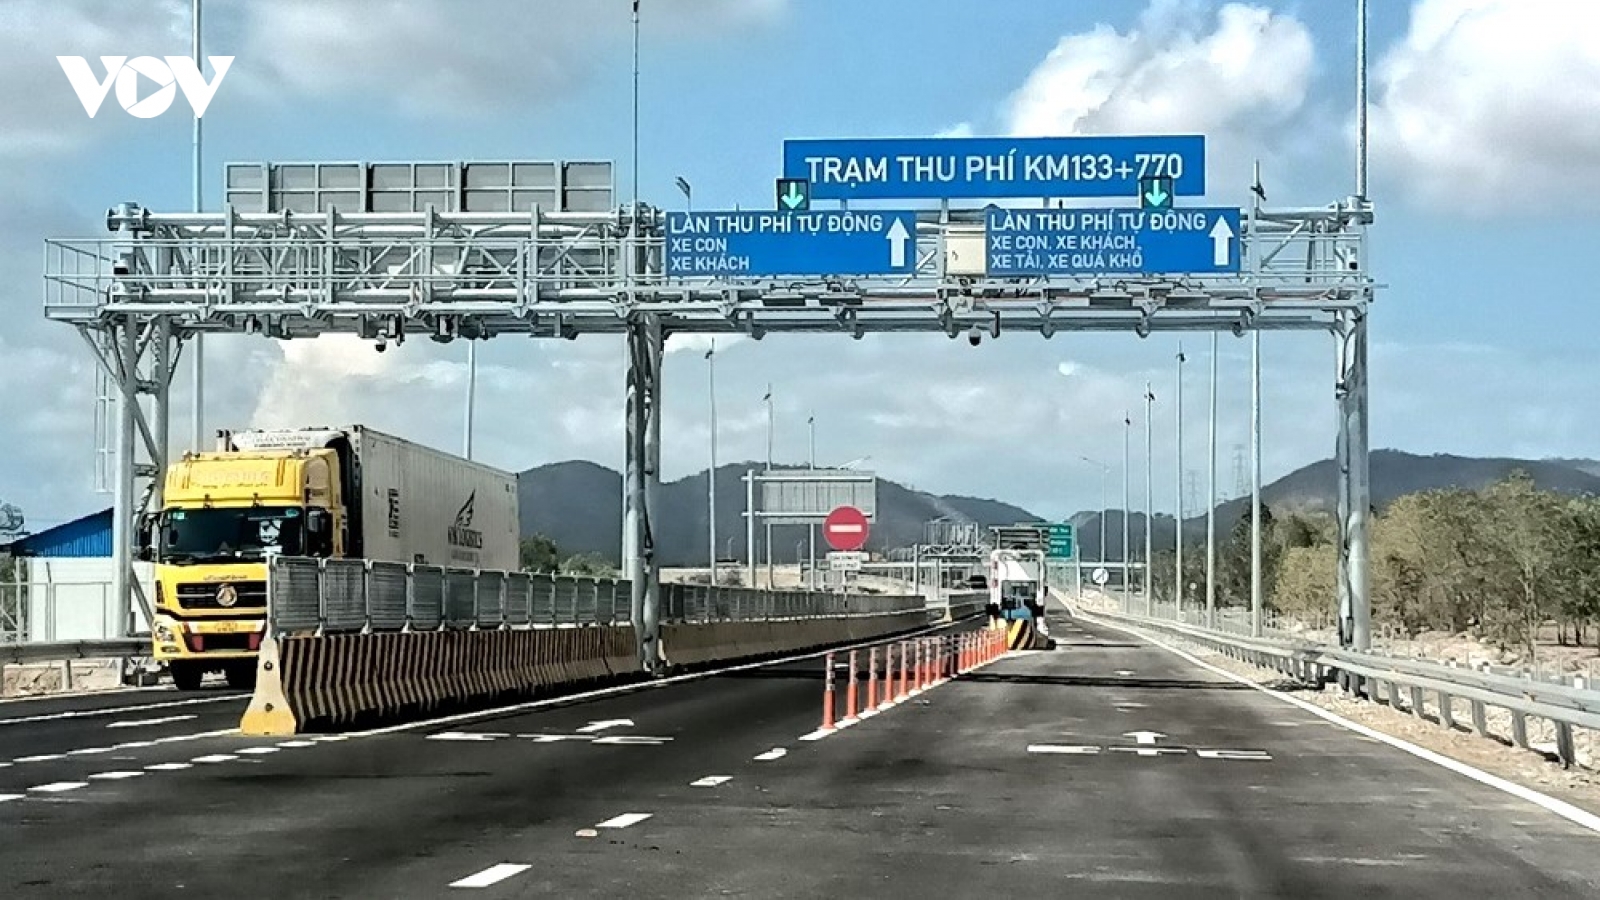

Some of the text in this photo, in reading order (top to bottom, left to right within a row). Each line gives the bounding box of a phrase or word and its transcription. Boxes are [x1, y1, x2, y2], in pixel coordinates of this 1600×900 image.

[805, 148, 1182, 188] TRẠM THU PHÍ KM133+770
[671, 211, 883, 236] LÀN THU PHÍ TỰ ĐỘNG
[991, 209, 1206, 234] LÀN THU PHÍ TỰ ĐỘNG
[671, 238, 727, 252] XE CON
[991, 236, 1012, 250] XE
[1055, 236, 1077, 250] XE
[671, 253, 750, 271] XE KHÁCH
[991, 254, 1012, 268] XE
[1047, 254, 1069, 268] XE
[1071, 250, 1105, 268] QUÁ
